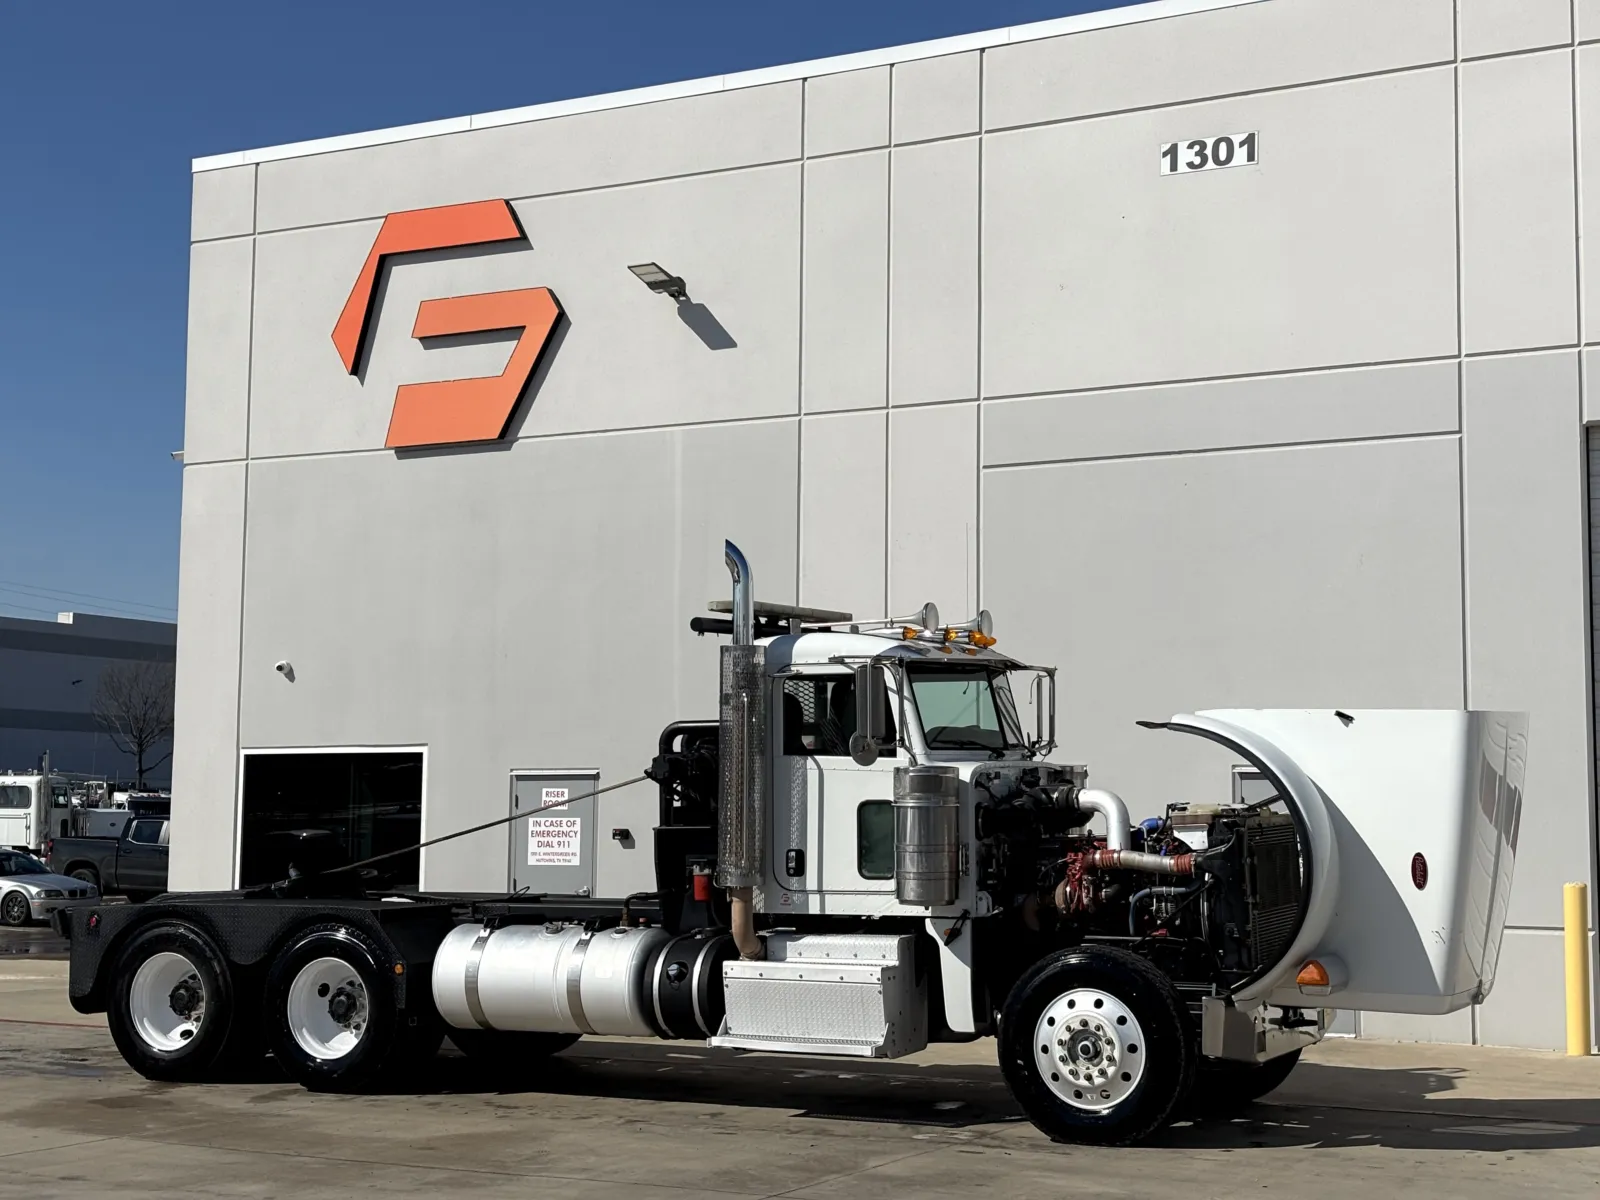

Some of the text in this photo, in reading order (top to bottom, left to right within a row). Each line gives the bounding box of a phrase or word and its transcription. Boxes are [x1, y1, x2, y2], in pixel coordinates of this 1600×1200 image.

[1162, 132, 1256, 173] 1301
[532, 820, 577, 828] IN CASE OF
[531, 830, 578, 838] EMERGENCY
[537, 840, 555, 848] DIAL
